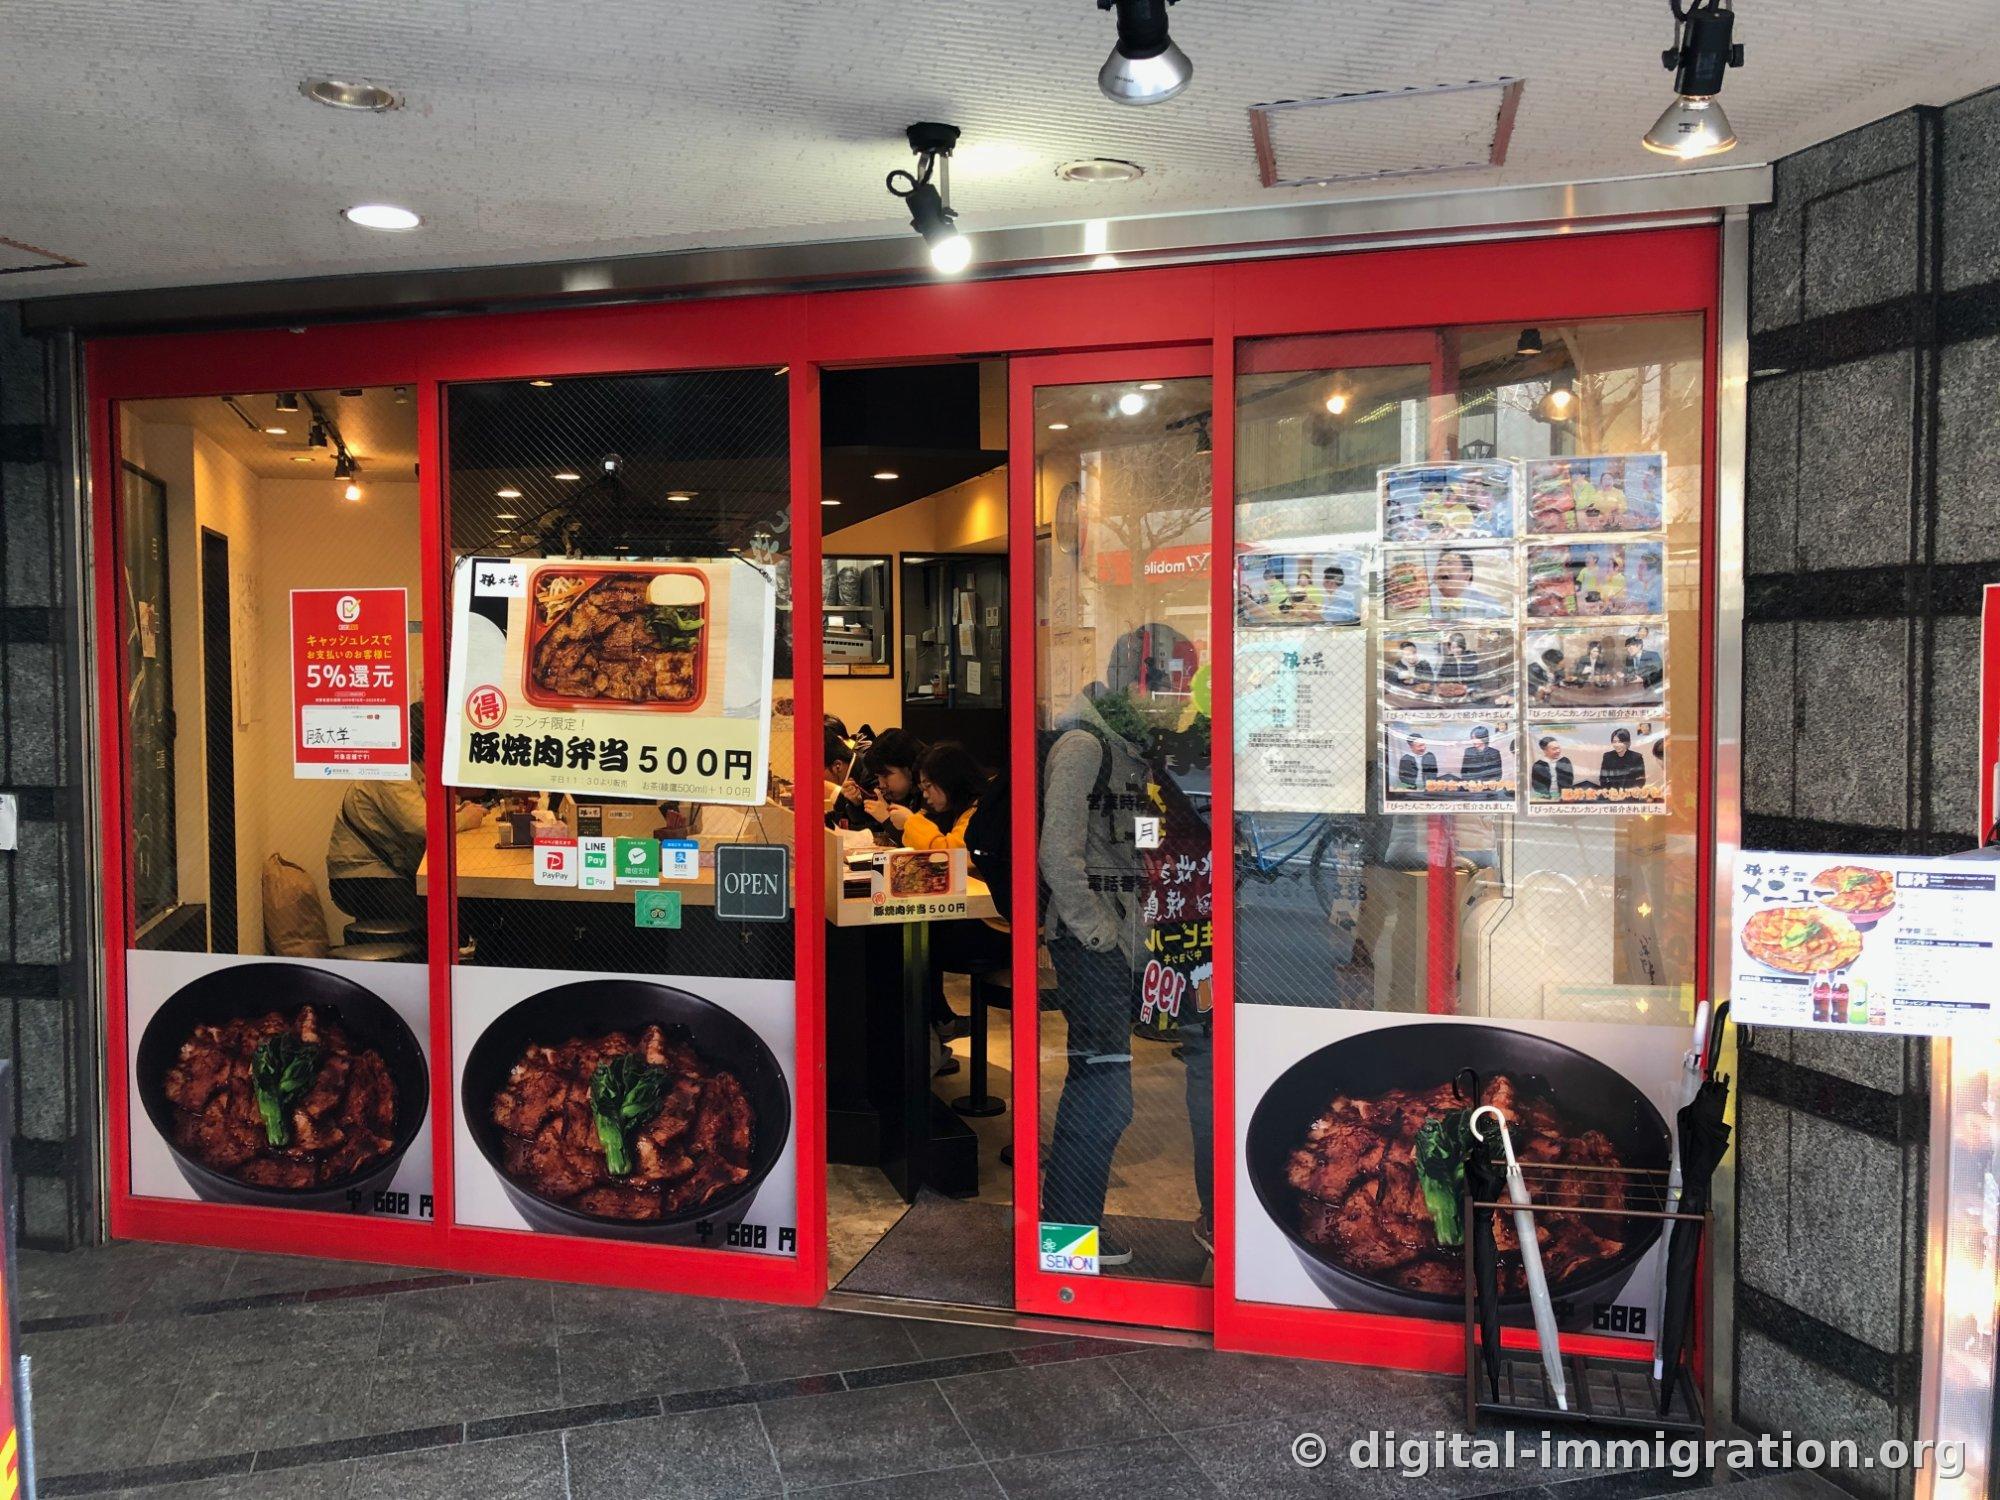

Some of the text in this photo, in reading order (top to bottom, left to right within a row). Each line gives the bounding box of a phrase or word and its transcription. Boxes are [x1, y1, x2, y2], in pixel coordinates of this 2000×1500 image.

[306, 634, 393, 647] キャッシュレスで
[306, 649, 393, 660] お支払いのお客様に
[306, 664, 394, 689] 5%還元
[472, 692, 500, 723] 得
[512, 715, 587, 732] ランチ限定!
[1385, 802, 1514, 813] 「ぴったんこカンカン」で紹介されました
[1529, 804, 1662, 816] 「ぴったんこカンカン」で紹介されました
[585, 842, 606, 851] LINE
[587, 856, 605, 866] Pay
[542, 871, 568, 881] PayPay
[595, 878, 606, 886] Pay
[724, 872, 779, 896] OPEN
[1046, 1254, 1093, 1271] SENON
